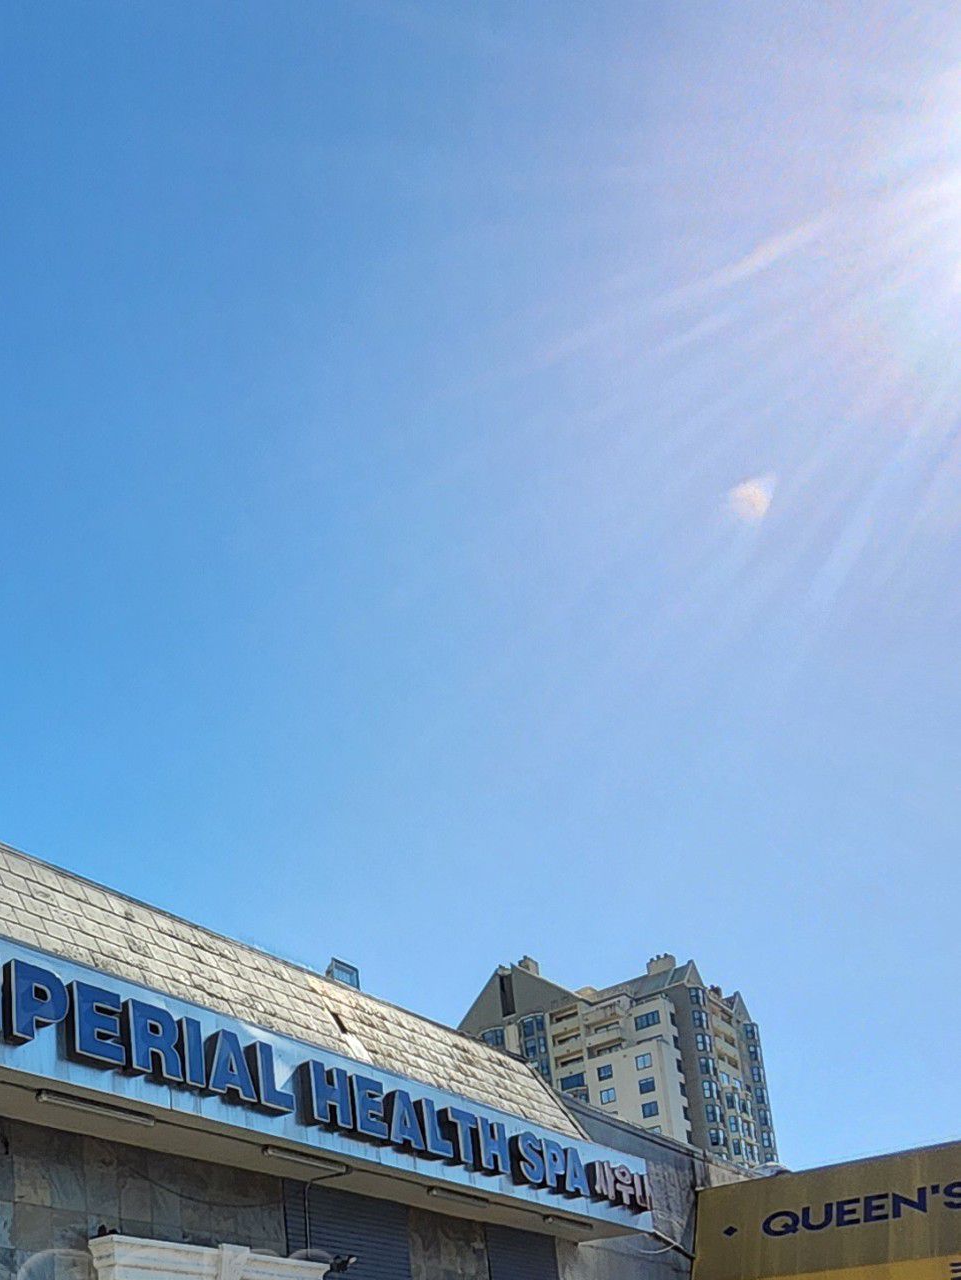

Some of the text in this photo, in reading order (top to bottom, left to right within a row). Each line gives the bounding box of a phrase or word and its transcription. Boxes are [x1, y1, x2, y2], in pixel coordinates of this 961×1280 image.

[303, 1058, 511, 1177] HEALTH
[513, 1131, 590, 1198] SPA
[594, 1160, 653, 1212] 사우나
[761, 1181, 961, 1237] QUEEN'S
